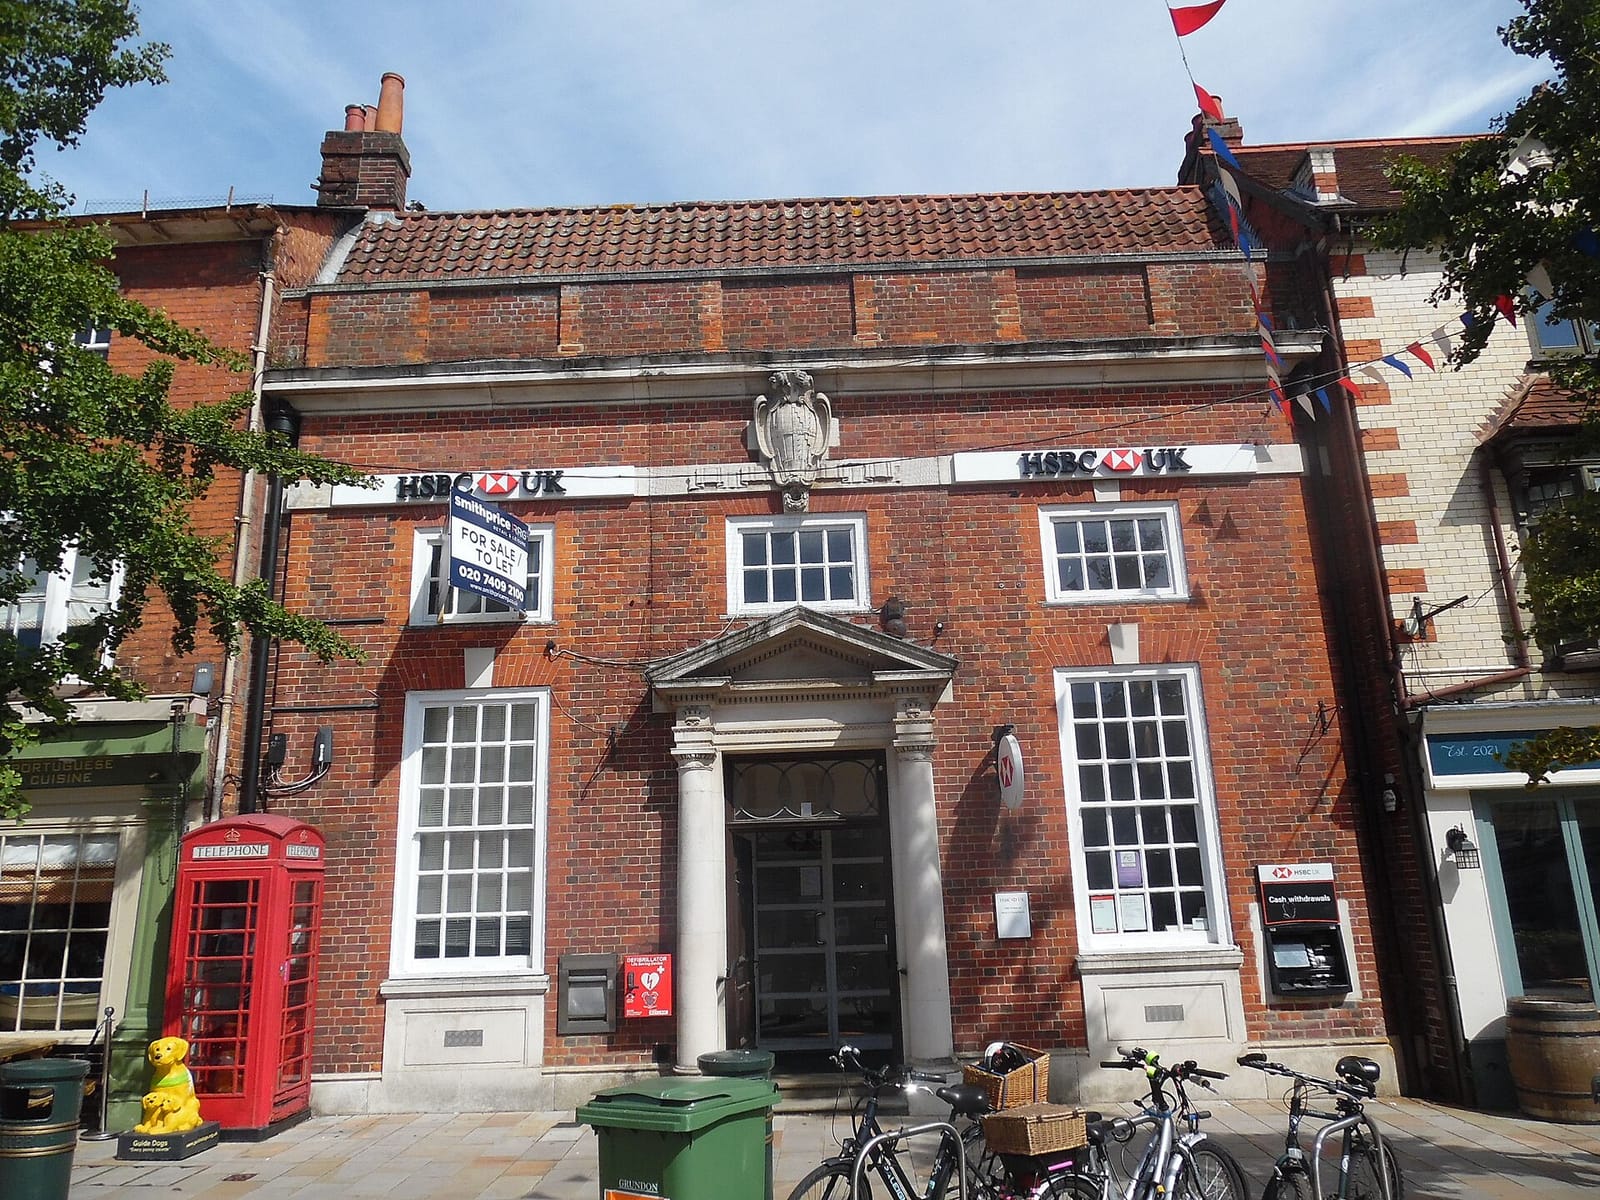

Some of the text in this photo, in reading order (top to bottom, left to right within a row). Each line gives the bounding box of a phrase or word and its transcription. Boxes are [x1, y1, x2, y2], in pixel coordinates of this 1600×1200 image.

[1021, 448, 1192, 475] HSBC UK
[397, 470, 567, 498] HSBC UK
[454, 495, 511, 531] smithprice
[462, 526, 487, 549] FOR
[490, 539, 516, 562] SALE
[476, 548, 513, 575] TO LET
[458, 565, 524, 602] 020 7409 2100
[1473, 745, 1498, 756] 2021
[30, 773, 92, 785] CUISINE
[198, 844, 266, 857] TELEPHONE
[287, 845, 318, 857] TELEPHONE
[1268, 894, 1331, 903] Cash withdrawals
[132, 1139, 168, 1148] Guide Dogs
[618, 1178, 659, 1193] GRUNDON
